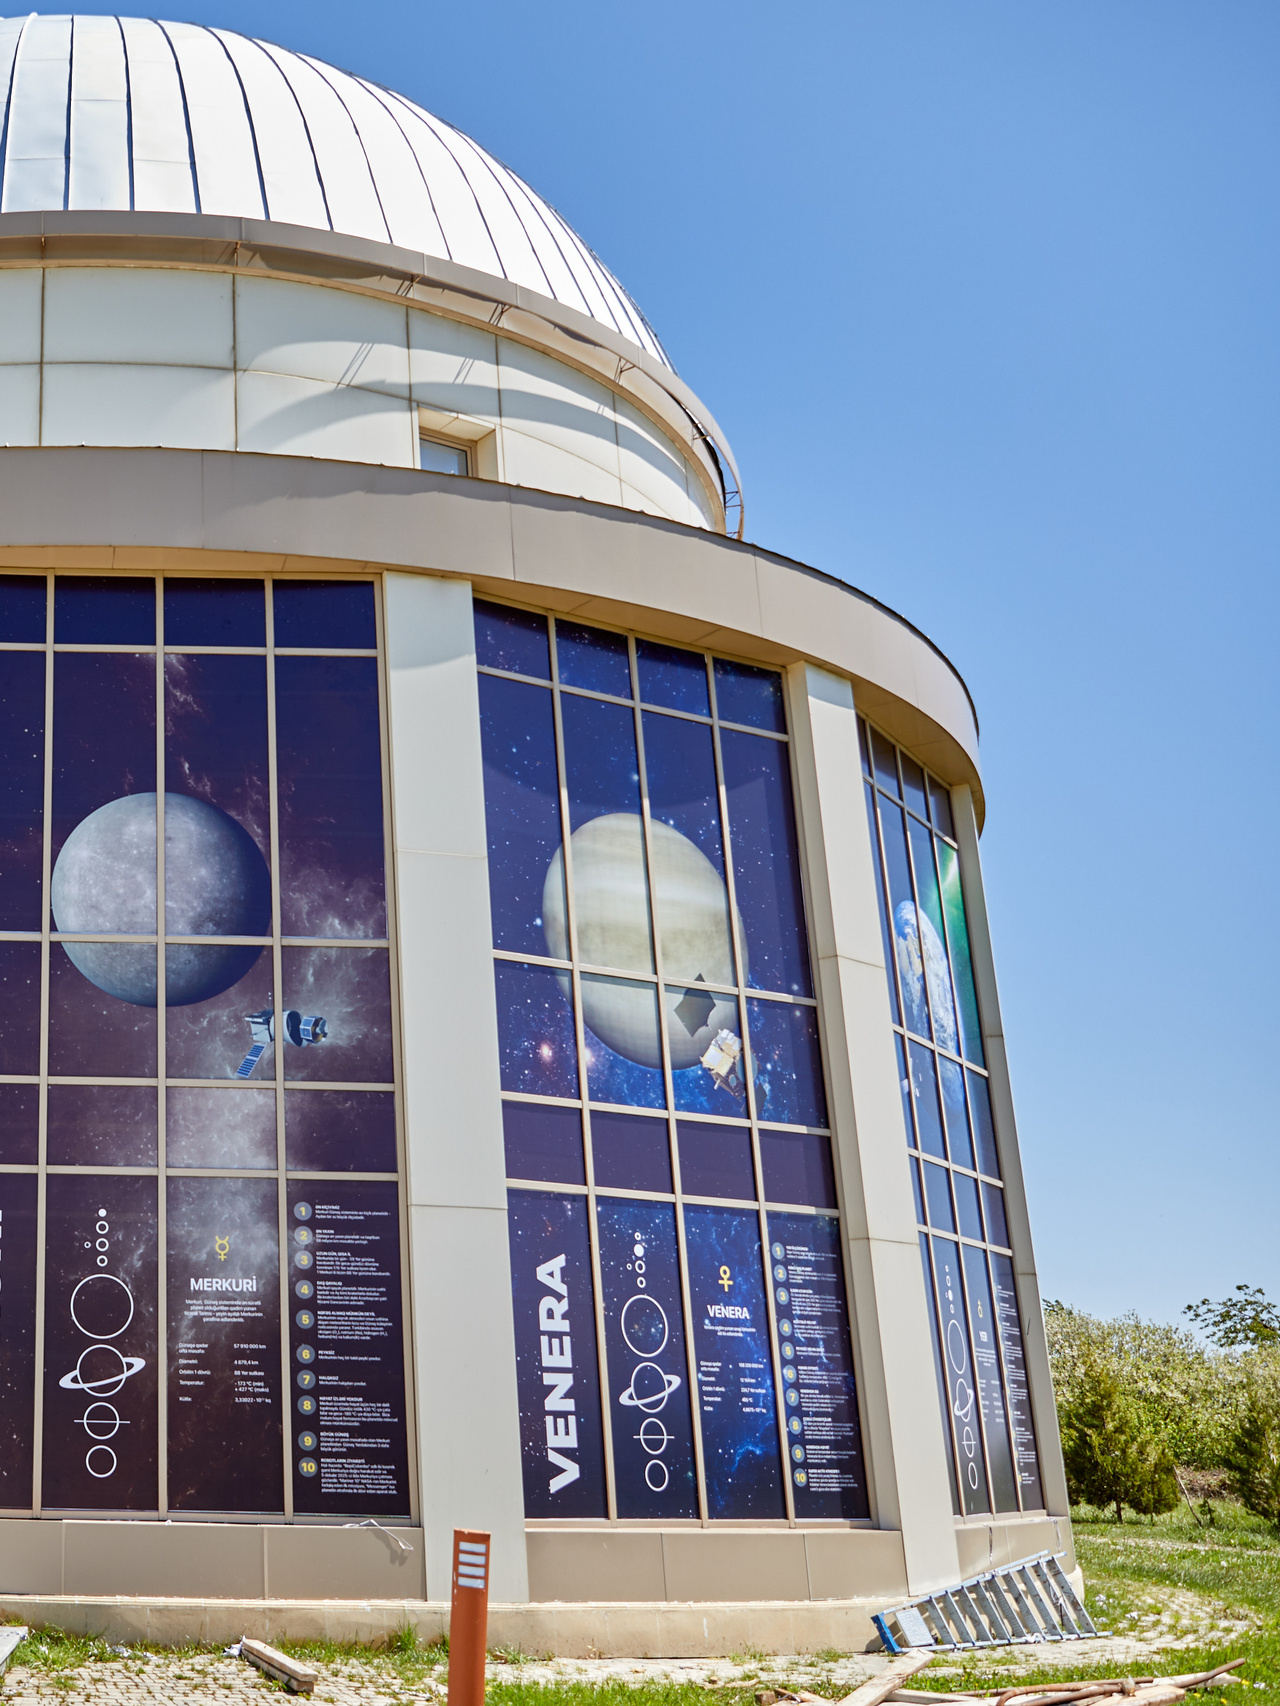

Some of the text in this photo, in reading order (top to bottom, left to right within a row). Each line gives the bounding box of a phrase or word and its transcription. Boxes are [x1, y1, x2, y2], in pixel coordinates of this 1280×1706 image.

[300, 1206, 306, 1216] 1
[300, 1230, 308, 1241] 2
[775, 1246, 781, 1256] 1
[301, 1255, 308, 1265] 3
[777, 1268, 784, 1278] 2
[190, 1275, 257, 1292] MERKURİ
[301, 1285, 309, 1294] 4
[779, 1291, 786, 1301] 3
[707, 1304, 750, 1320] VENERA
[302, 1314, 310, 1324] 5
[782, 1323, 789, 1332] 4
[302, 1349, 310, 1359] 6
[785, 1346, 792, 1356] 5
[536, 1253, 580, 1494] VENERA
[303, 1374, 311, 1384] 7
[789, 1392, 796, 1402] 7
[303, 1400, 311, 1410] 8
[792, 1420, 799, 1430] 8
[304, 1436, 312, 1446] 9
[795, 1448, 802, 1458] 9
[301, 1462, 315, 1473] 10
[796, 1472, 807, 1482] 10
